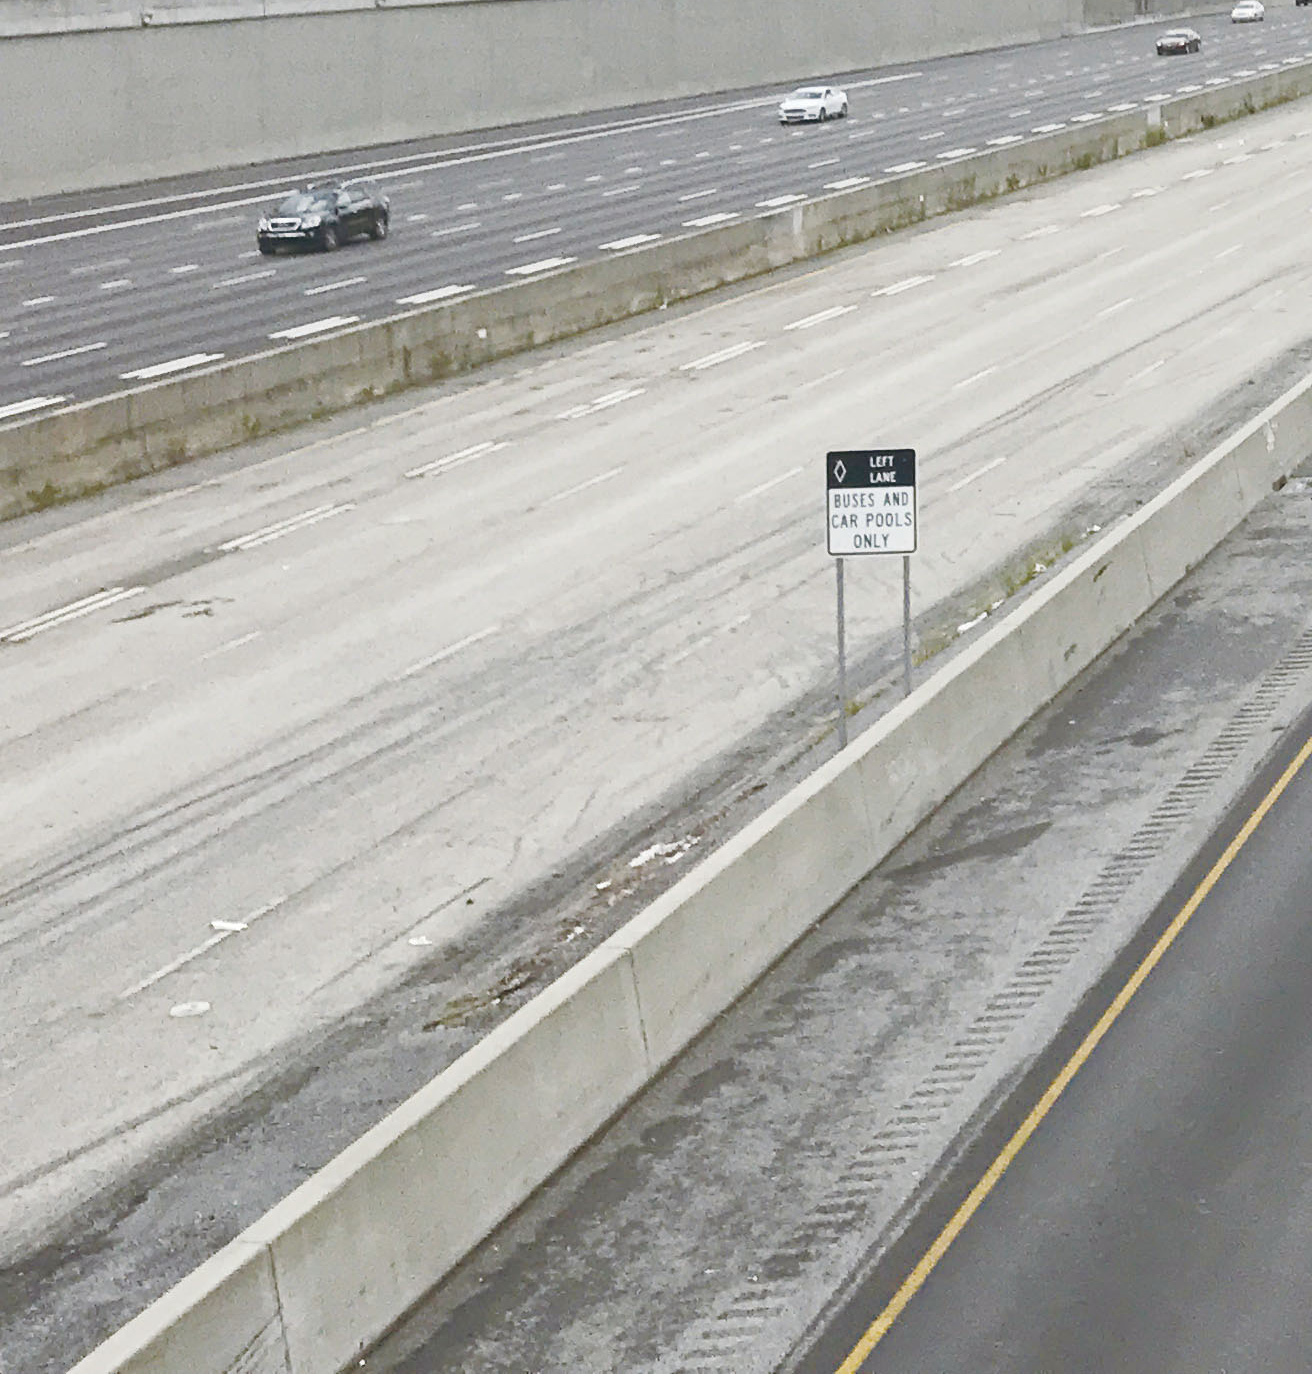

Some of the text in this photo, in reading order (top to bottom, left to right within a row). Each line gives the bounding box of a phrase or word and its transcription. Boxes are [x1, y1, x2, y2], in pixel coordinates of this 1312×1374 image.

[870, 456, 894, 468] LEFT
[870, 471, 896, 483] LANE
[834, 492, 908, 508] BUSES AND
[832, 512, 912, 528] CAR POOLS
[854, 534, 890, 548] ONLY
